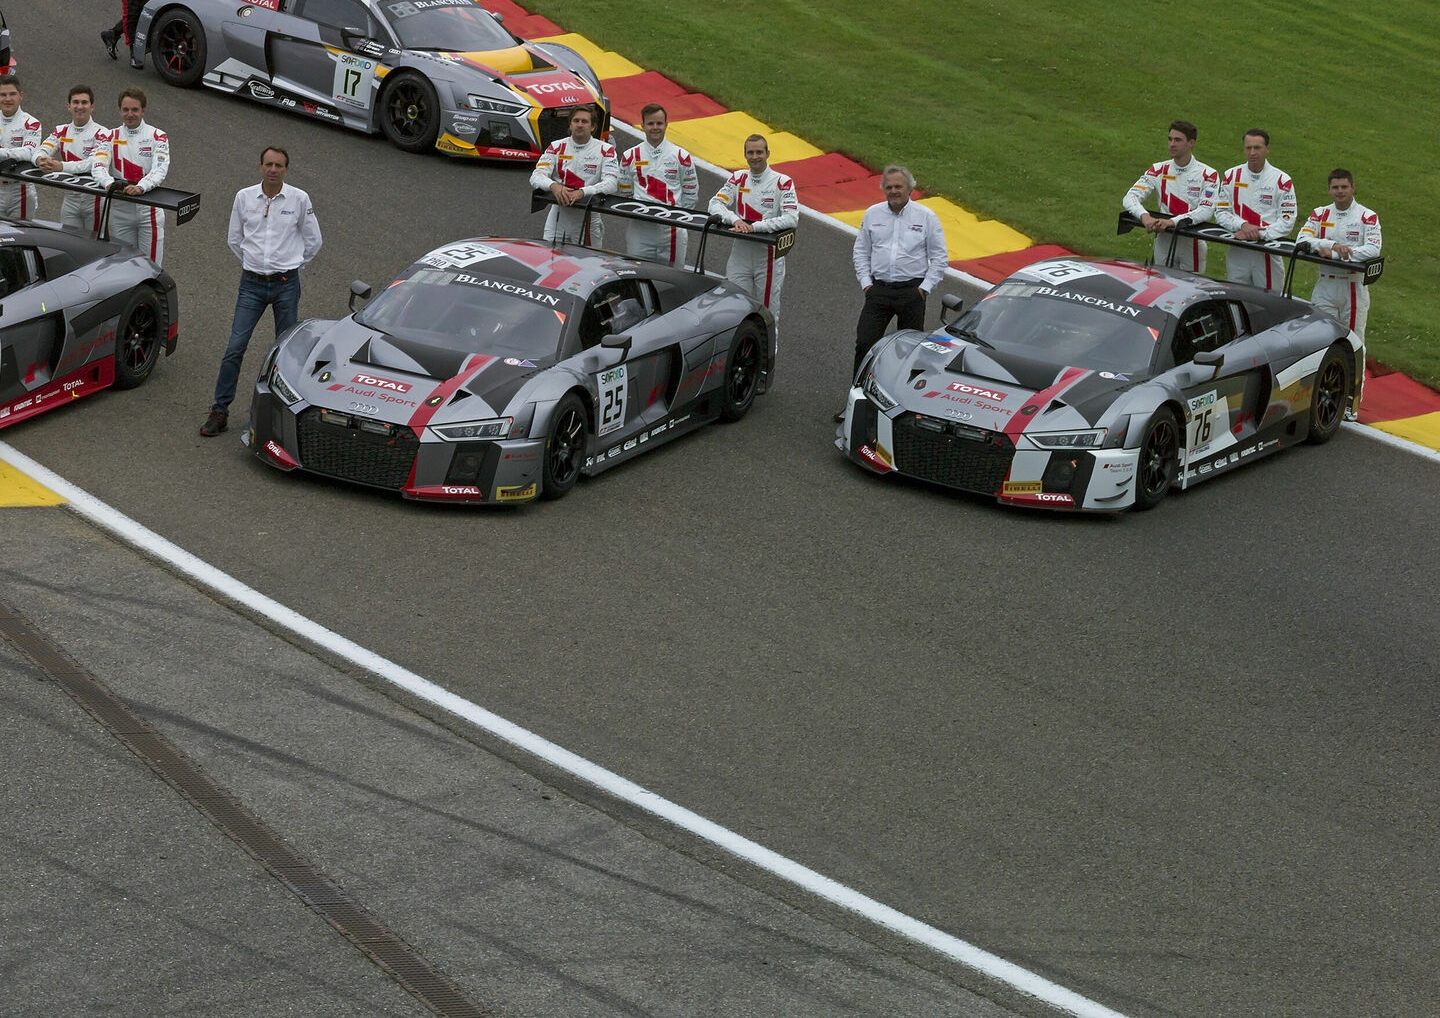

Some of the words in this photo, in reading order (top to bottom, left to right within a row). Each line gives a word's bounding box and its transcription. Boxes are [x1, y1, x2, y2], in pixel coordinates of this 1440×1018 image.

[344, 69, 362, 96] 17
[525, 81, 586, 95] TOTAL
[453, 114, 478, 123] Snap-on
[499, 150, 530, 159] TOTAL
[441, 246, 488, 261] 25
[1039, 263, 1082, 278] 76
[455, 272, 561, 307] BLANCPAIN
[1036, 286, 1142, 318] BLANCPAIN
[62, 379, 84, 391] TOTAL
[356, 374, 409, 393] TOTAL
[951, 382, 1003, 400] TOTAL
[344, 385, 376, 398] Audi
[378, 390, 417, 408] Sport
[941, 393, 972, 406] Audi
[974, 398, 1013, 416] Sport
[602, 385, 624, 425] 25
[1194, 409, 1212, 446] 76
[266, 441, 281, 457] TOTAL
[860, 445, 876, 461] TOTAL
[442, 487, 479, 495] TOTAL
[1004, 482, 1042, 493] PIRELLI
[1035, 493, 1072, 502] TOTAL
